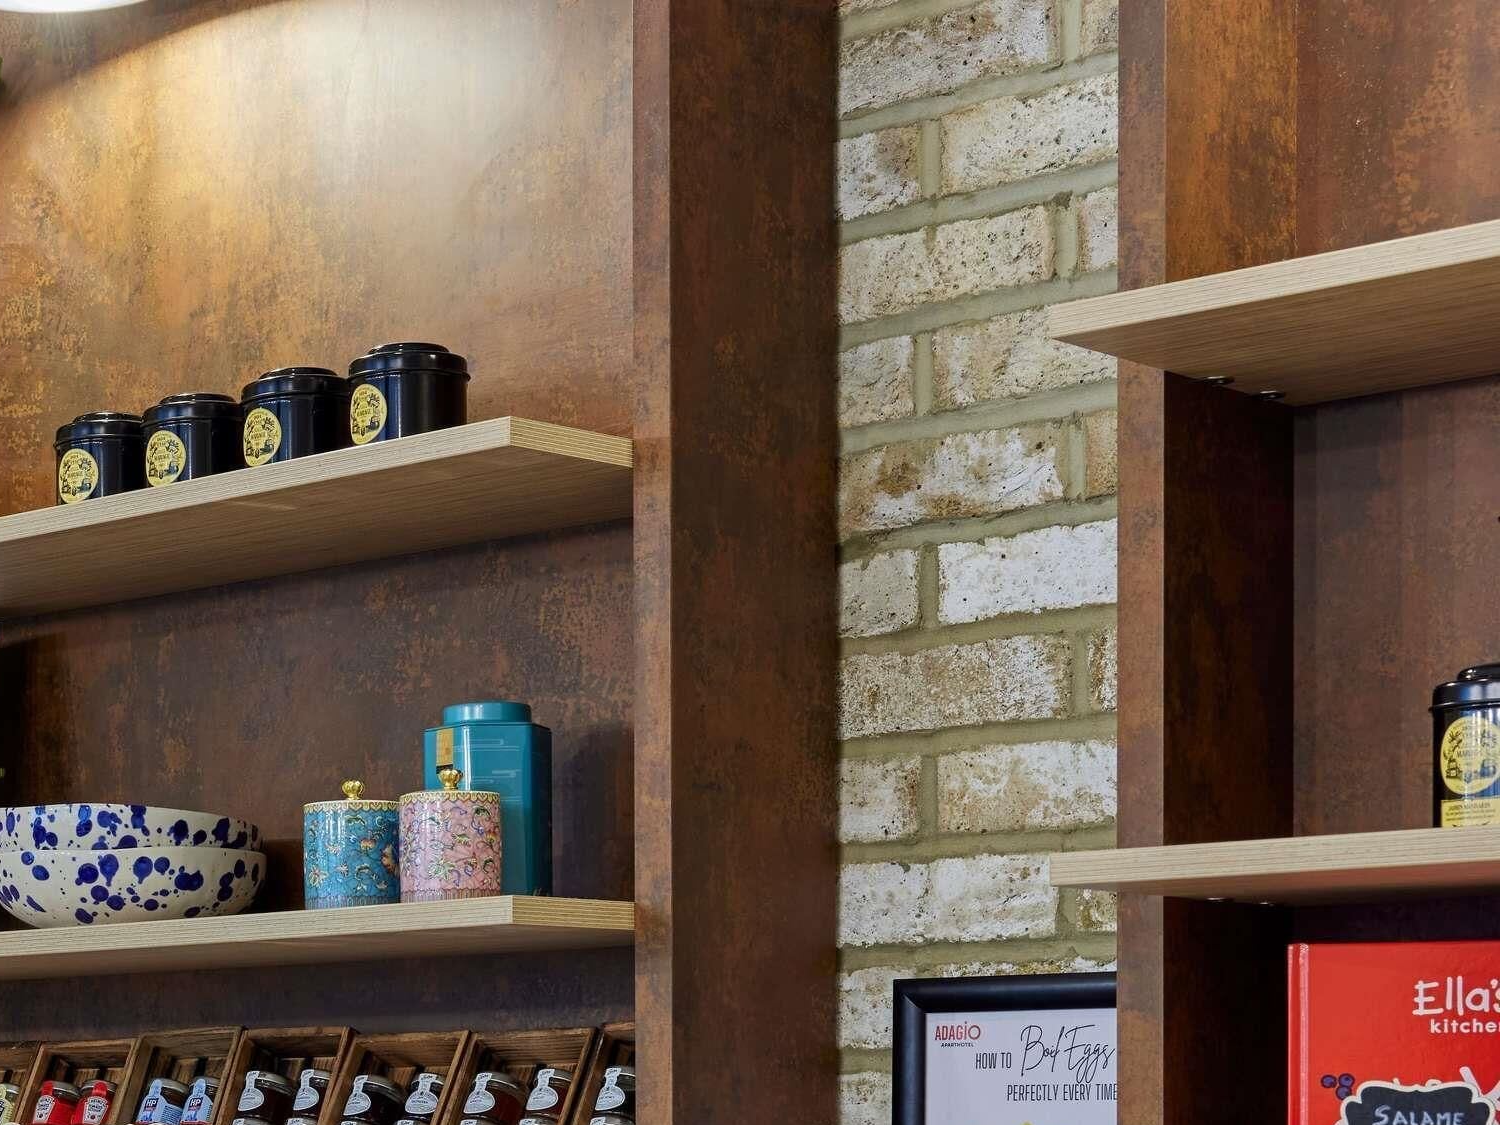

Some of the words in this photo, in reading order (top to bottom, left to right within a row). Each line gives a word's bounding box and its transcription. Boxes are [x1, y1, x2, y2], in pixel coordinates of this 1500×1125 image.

[975, 1053, 997, 1070] HOW
[1001, 1052, 1012, 1069] TO
[1020, 1024, 1061, 1077] Boil
[1064, 1024, 1116, 1083] Eggs
[1007, 1084, 1059, 1101] PERFECTLY
[1063, 1084, 1091, 1101] EVERY
